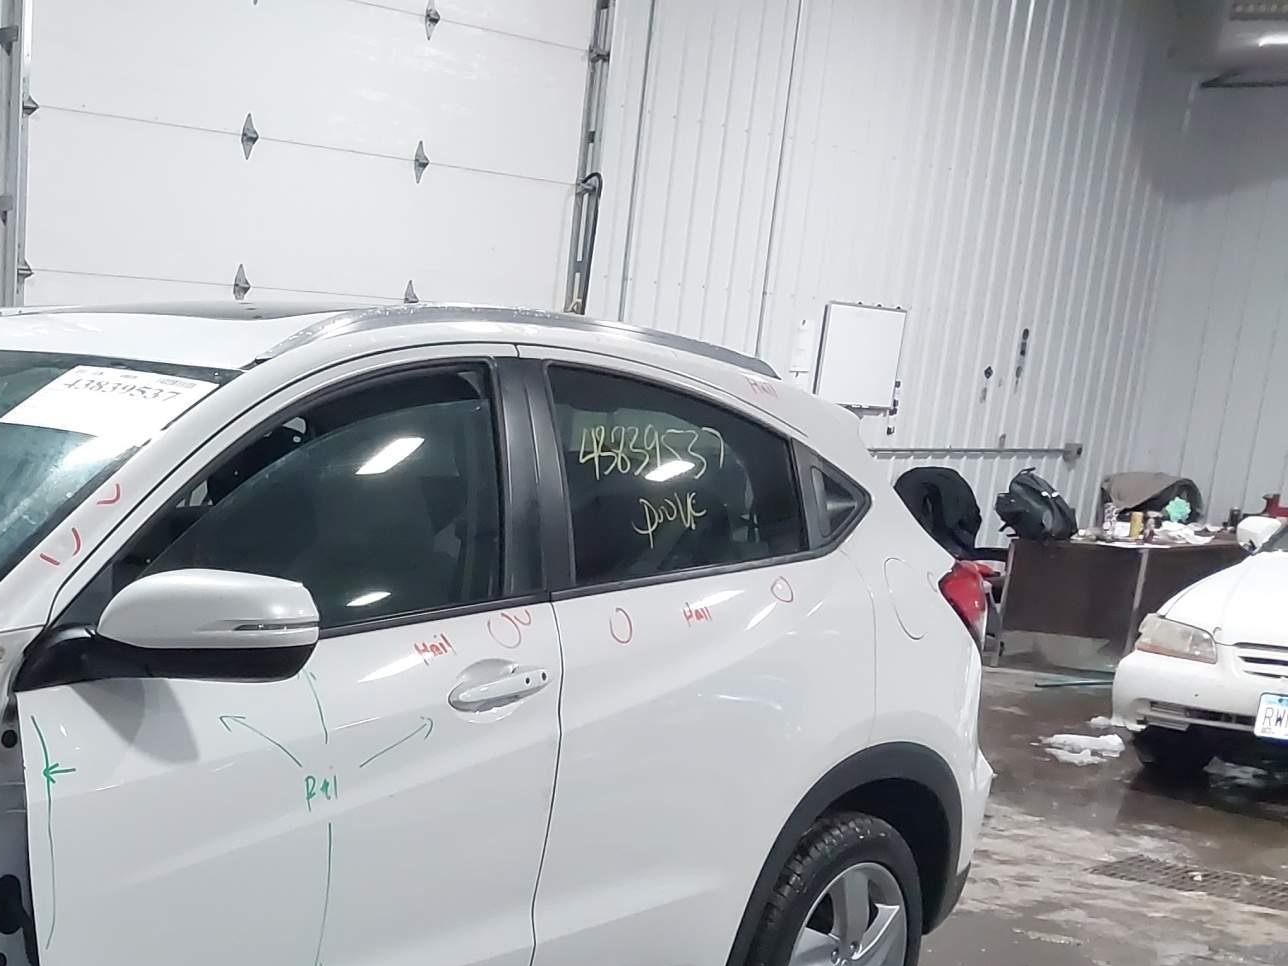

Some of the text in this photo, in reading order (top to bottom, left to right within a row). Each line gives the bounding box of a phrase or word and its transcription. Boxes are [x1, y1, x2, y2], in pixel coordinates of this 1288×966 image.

[64, 378, 182, 402] 43839537
[579, 423, 725, 481] 43839537
[1262, 706, 1288, 728] RW
